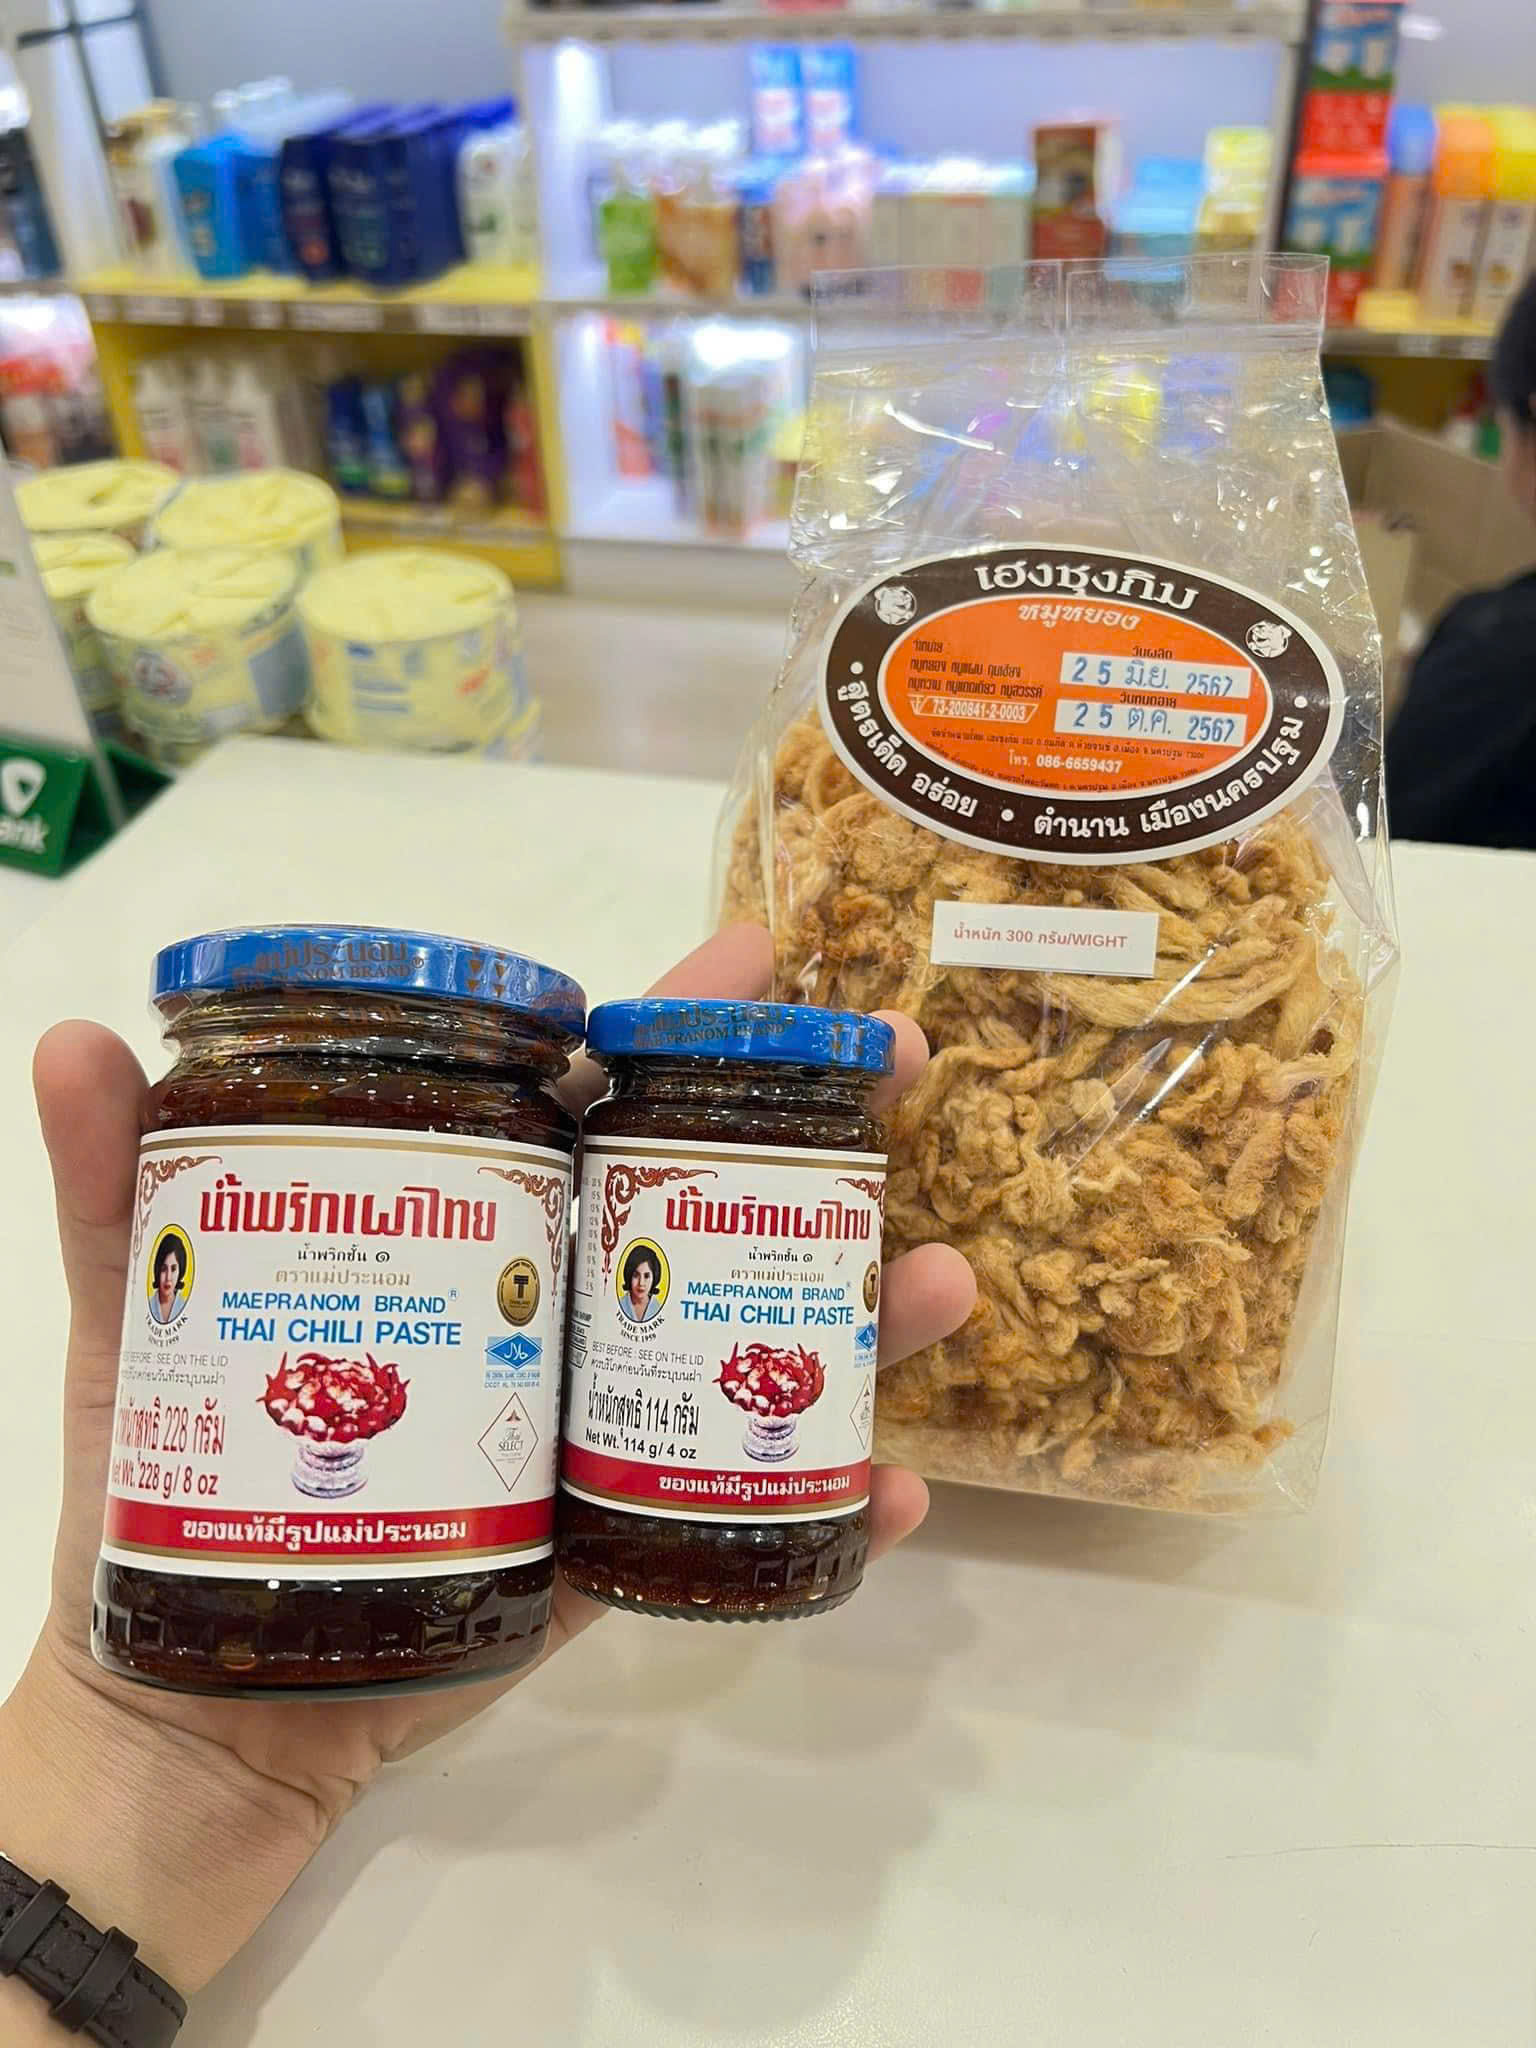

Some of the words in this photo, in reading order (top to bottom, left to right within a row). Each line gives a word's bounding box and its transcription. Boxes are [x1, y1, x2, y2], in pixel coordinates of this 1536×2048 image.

[974, 560, 1199, 610] เฮงชุงกิม
[1018, 604, 1141, 631] หมูหยอง
[1186, 672, 1233, 697] 2567
[1187, 715, 1235, 742] 2567
[911, 772, 978, 818] อร่อย
[1034, 806, 1129, 838] ตำนาน
[1140, 716, 1304, 833] เมืองนครปฐม
[1036, 754, 1122, 774] 086-6659437
[953, 922, 1001, 942] น้ำหนัก
[1006, 929, 1033, 944] 300
[200, 1174, 497, 1241] น้ำพริกเผาไทย
[666, 1186, 871, 1241] น้ำพริกเผาไทย
[298, 1243, 367, 1262] น้ำพริกชั้น
[275, 1265, 411, 1286] ตราแม่ประนอม
[222, 1292, 361, 1312] MAEPRANOM
[687, 1281, 793, 1300] MAEPRANOM
[802, 1287, 845, 1301] BRAND
[616, 1311, 637, 1333] TRADE
[640, 1316, 665, 1334] MARK
[680, 1300, 730, 1322] THAI
[740, 1304, 795, 1325] CHILI
[803, 1306, 854, 1325] PASTE
[217, 1317, 275, 1342] THAI
[288, 1319, 362, 1344] CHILI
[375, 1322, 462, 1346] PASTE
[157, 1353, 171, 1365] SEE
[173, 1354, 187, 1366] ON
[190, 1354, 208, 1367] THE
[211, 1355, 229, 1368] LID
[592, 1340, 606, 1353] BEST
[638, 1349, 653, 1361] SEE
[655, 1351, 668, 1362] ON
[671, 1352, 687, 1365] THE
[689, 1353, 704, 1366] LID
[162, 1405, 189, 1453] 228
[193, 1396, 226, 1455] กรัม
[646, 1397, 669, 1434] 114
[673, 1391, 699, 1436] กรัม
[586, 1427, 600, 1445] Net
[603, 1432, 619, 1449] Wt.
[624, 1437, 645, 1454] 114
[667, 1443, 675, 1457] 4
[680, 1447, 696, 1459] oz
[138, 1461, 160, 1491] 228
[183, 1466, 193, 1493] 8
[198, 1474, 218, 1495] oz
[659, 1474, 851, 1501] ของแท้มีรูปแม่ประนอม
[182, 1514, 467, 1551] ของแท้มีรูปแม่ประนอม
